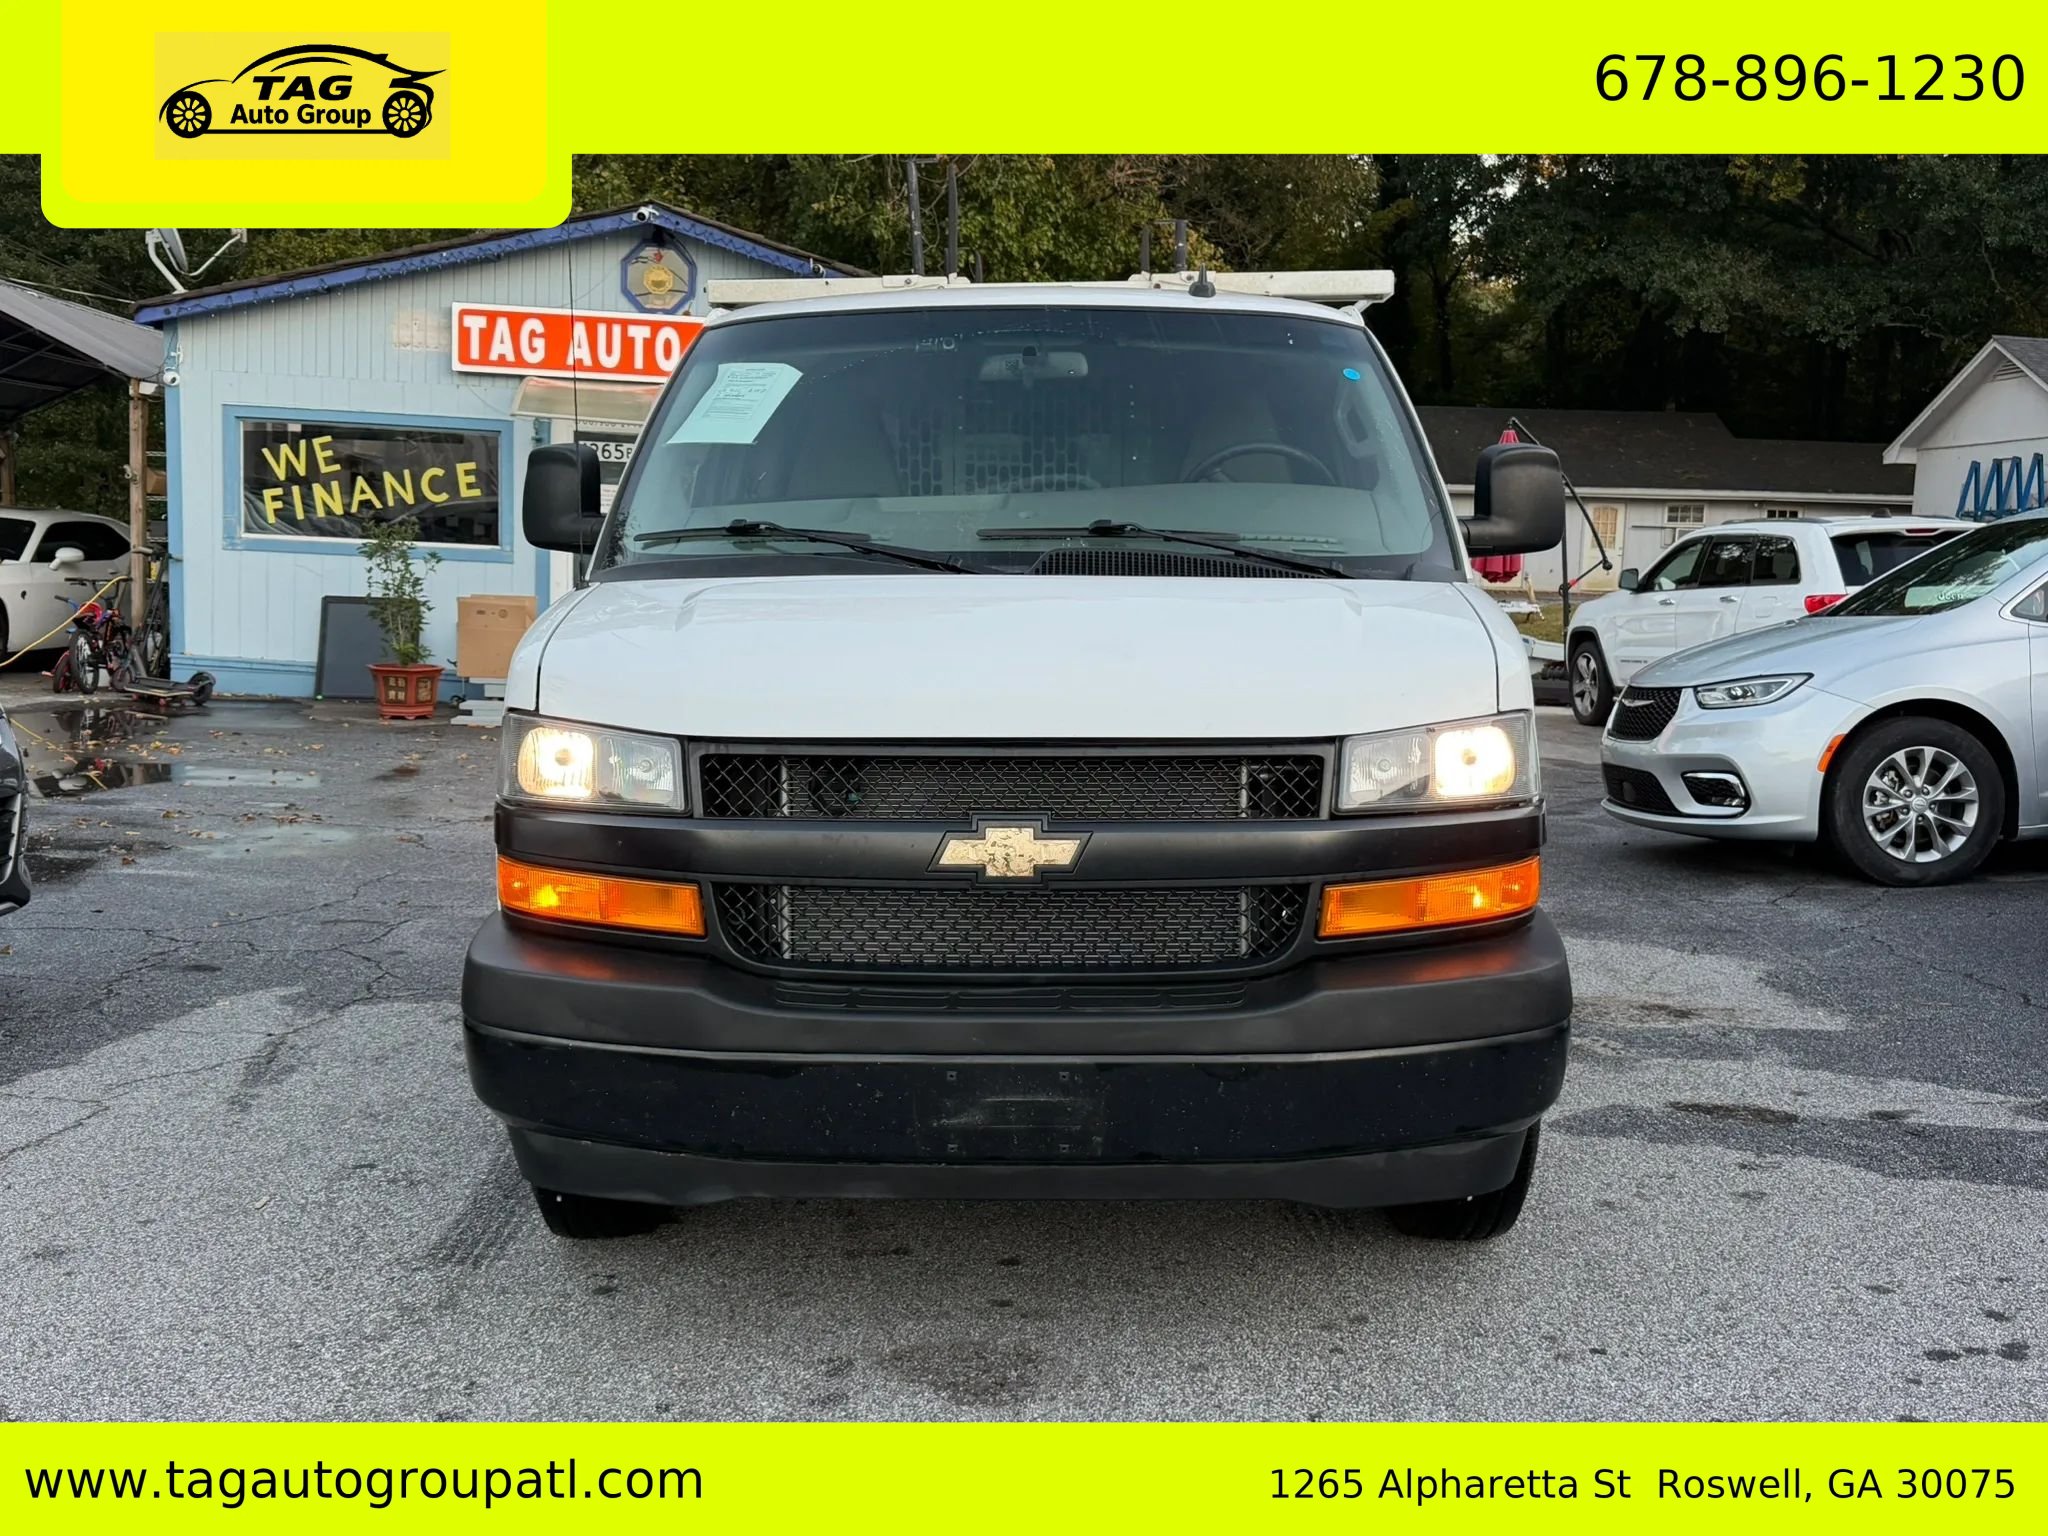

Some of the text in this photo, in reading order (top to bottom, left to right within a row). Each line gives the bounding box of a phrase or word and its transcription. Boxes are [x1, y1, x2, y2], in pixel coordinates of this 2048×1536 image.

[462, 314, 681, 372] TAG AUTO
[261, 435, 342, 482] WE
[262, 462, 482, 525] FINANCE
